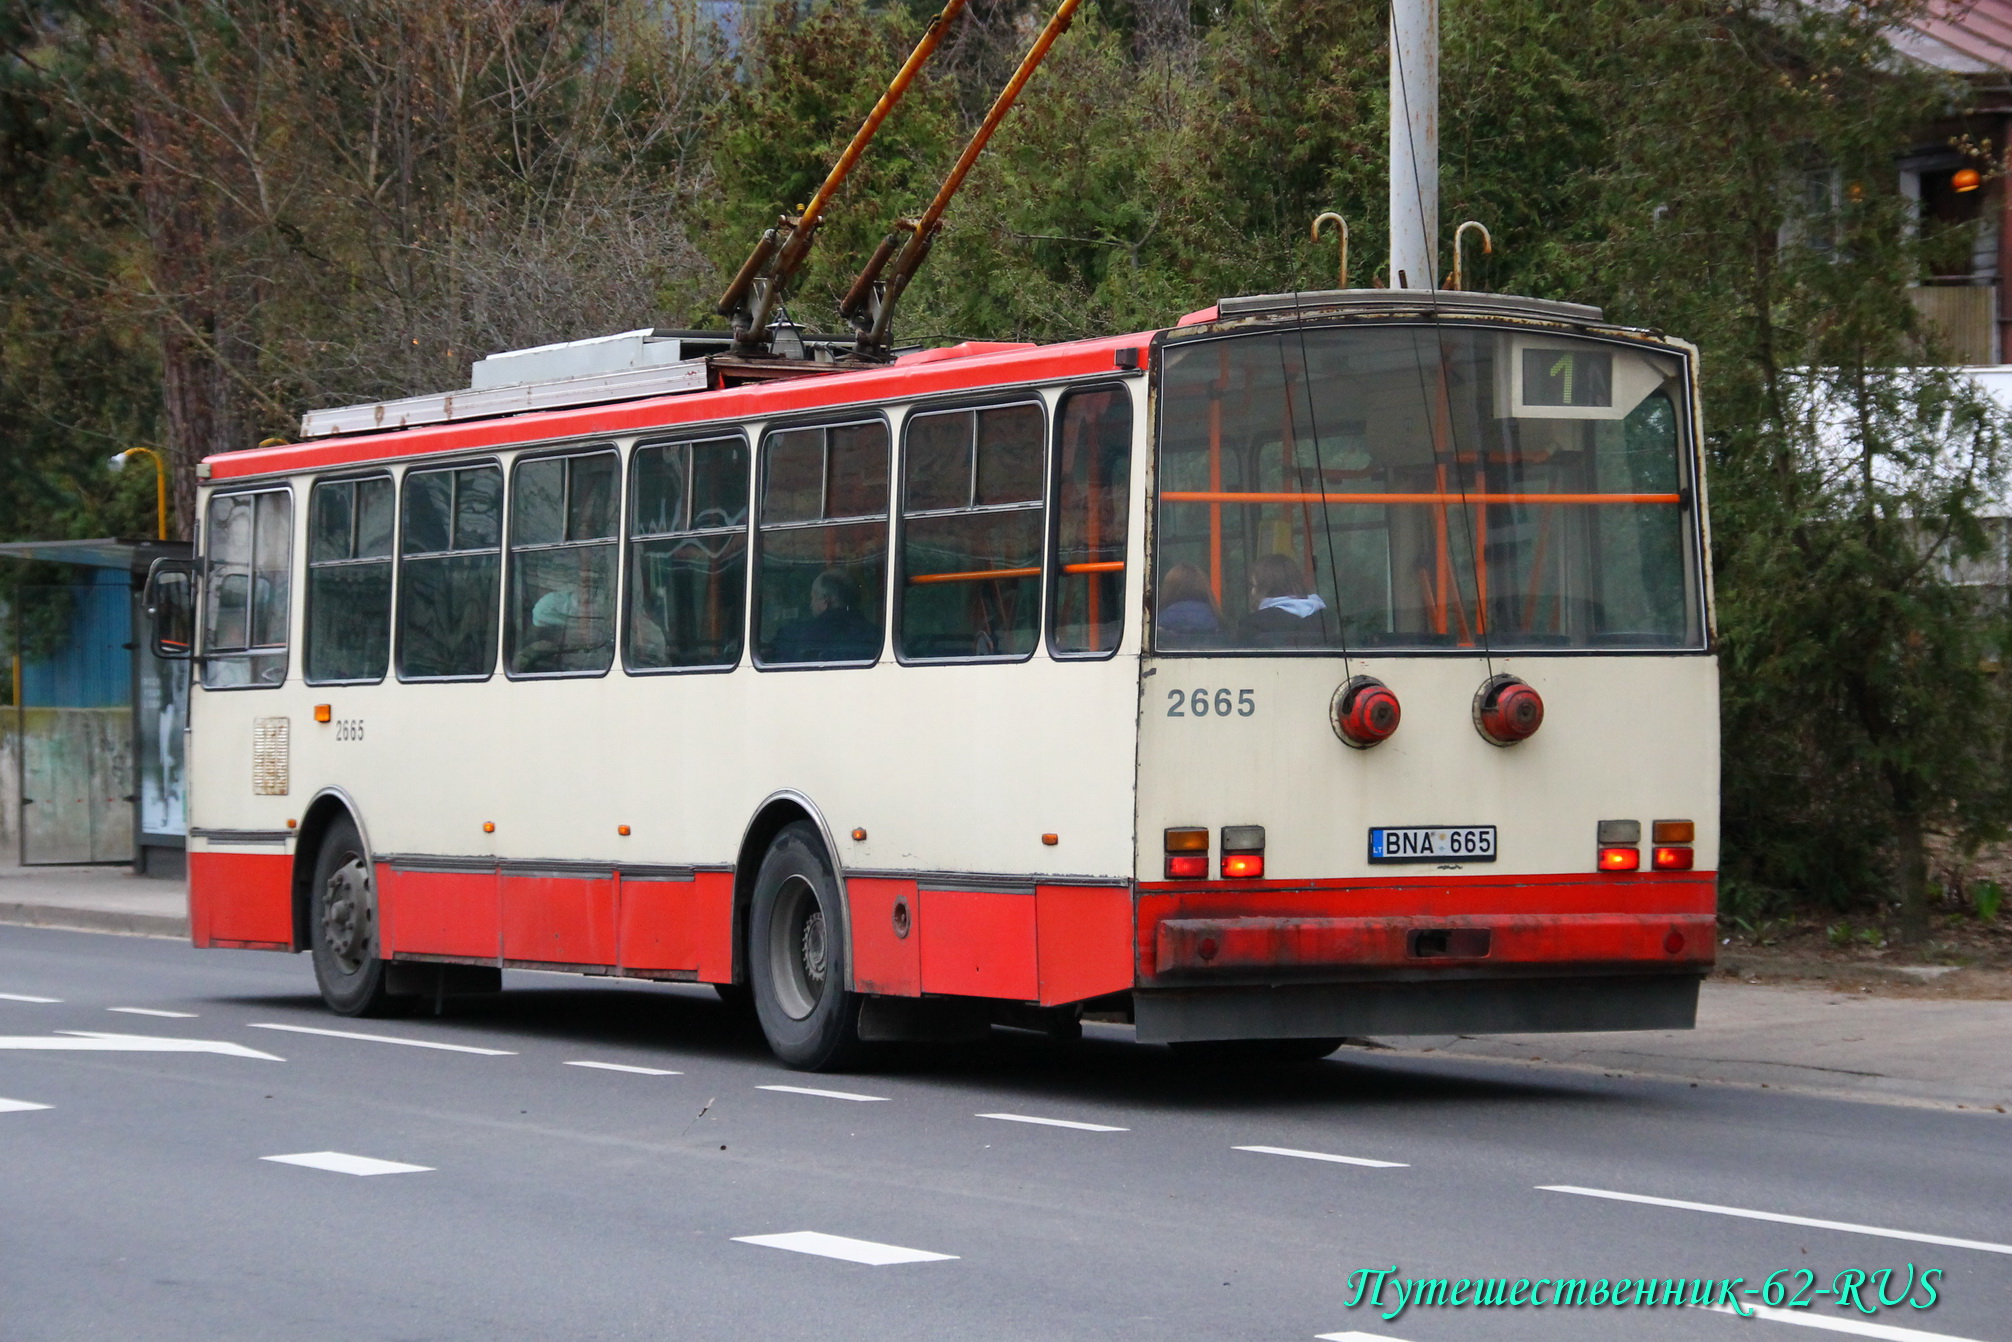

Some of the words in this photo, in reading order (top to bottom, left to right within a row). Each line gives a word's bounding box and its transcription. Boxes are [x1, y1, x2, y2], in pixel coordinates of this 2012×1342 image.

[1550, 353, 1574, 404] 1
[1167, 688, 1256, 717] 2665
[336, 720, 364, 741] 2665
[1372, 846, 1383, 854] LT
[1386, 831, 1434, 854] BNA
[1450, 830, 1491, 853] 665
